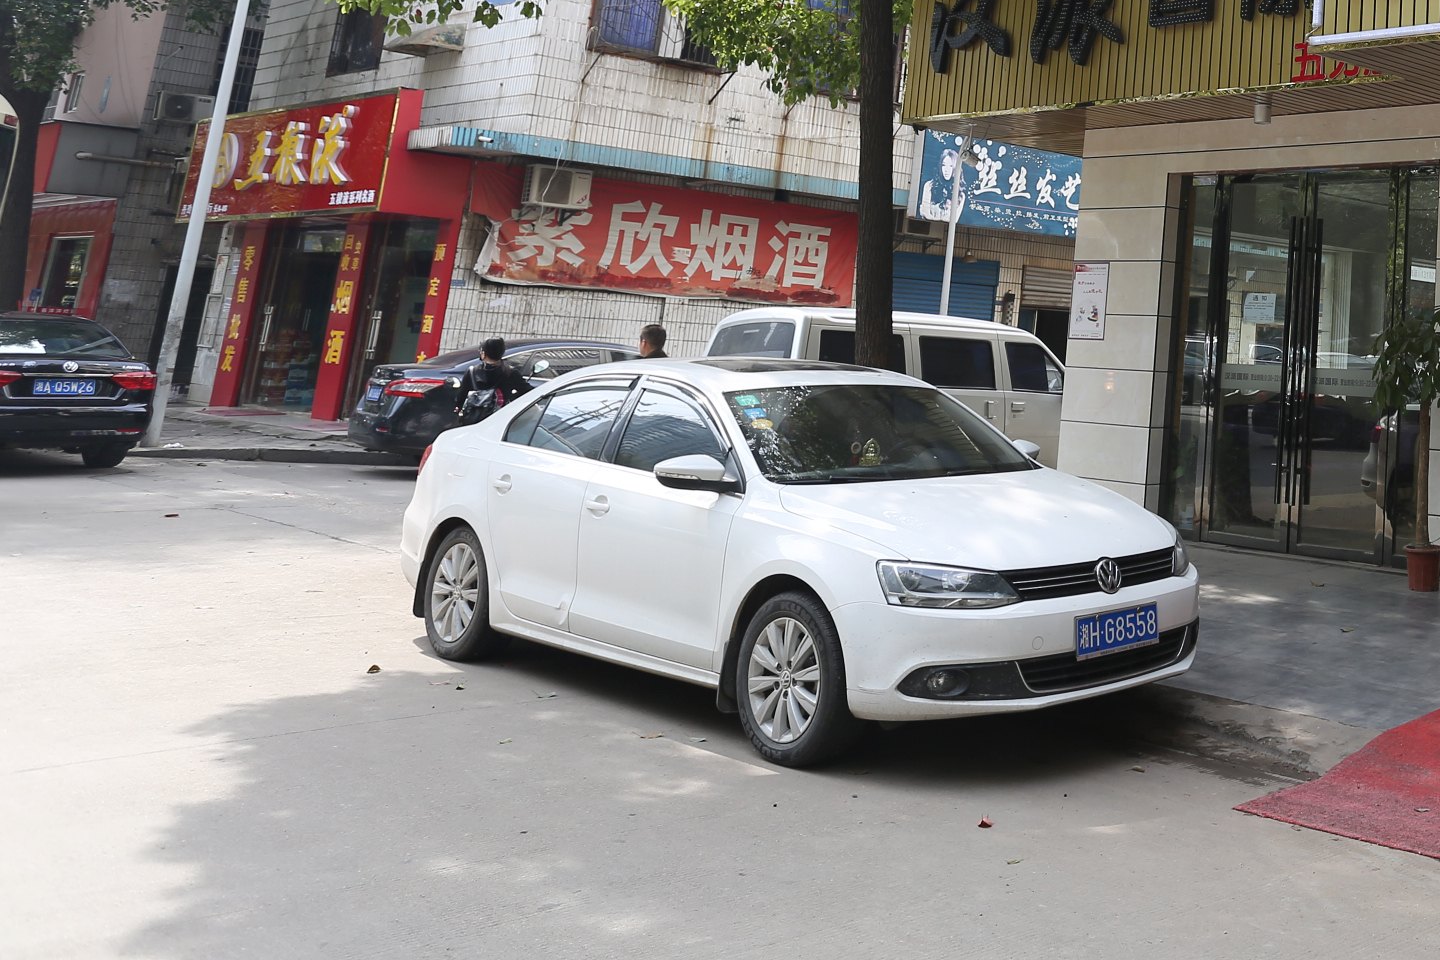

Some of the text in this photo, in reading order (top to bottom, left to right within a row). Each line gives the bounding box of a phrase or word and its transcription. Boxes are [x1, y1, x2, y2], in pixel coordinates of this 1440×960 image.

[234, 112, 352, 190] 五粮液
[221, 246, 256, 372] 零售批发
[324, 280, 354, 365] 烟酒
